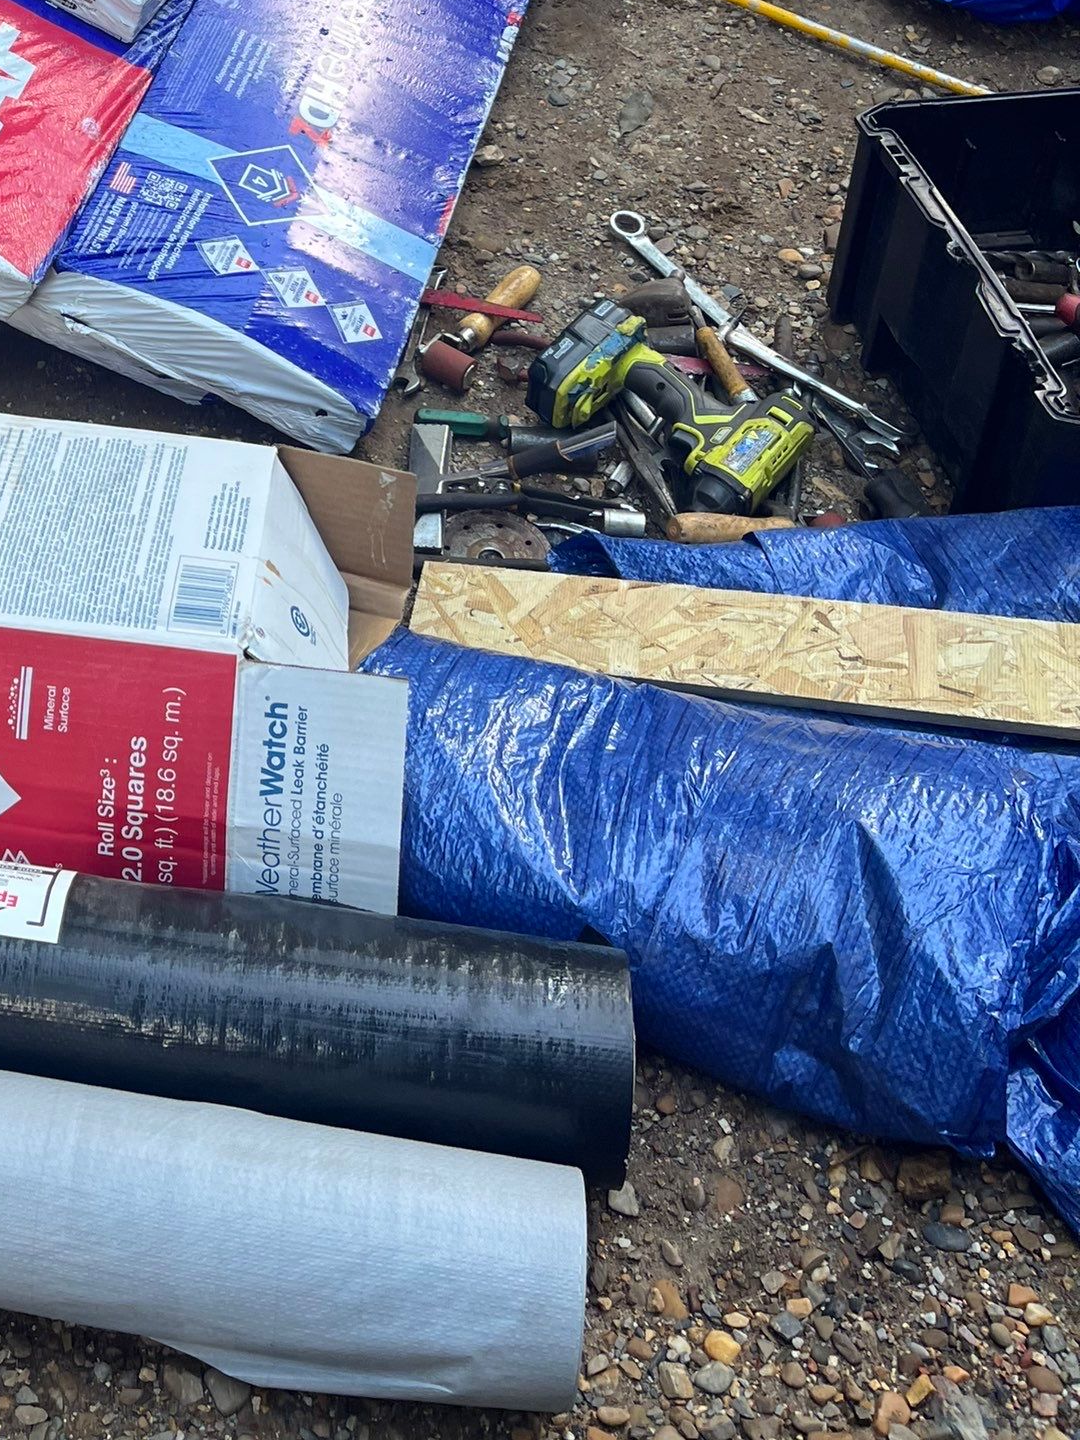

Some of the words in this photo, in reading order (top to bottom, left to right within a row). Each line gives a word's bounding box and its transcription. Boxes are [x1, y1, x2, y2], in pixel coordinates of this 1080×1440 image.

[43, 685, 56, 731] Mineral
[57, 687, 70, 733] Surface
[295, 704, 308, 750] Barrier
[121, 736, 149, 841] Squares
[156, 768, 180, 823] (18.6
[292, 751, 305, 796] Leak
[97, 813, 115, 858] Roll
[288, 798, 304, 897] neral-Surfaced
[122, 846, 143, 882] 2.0
